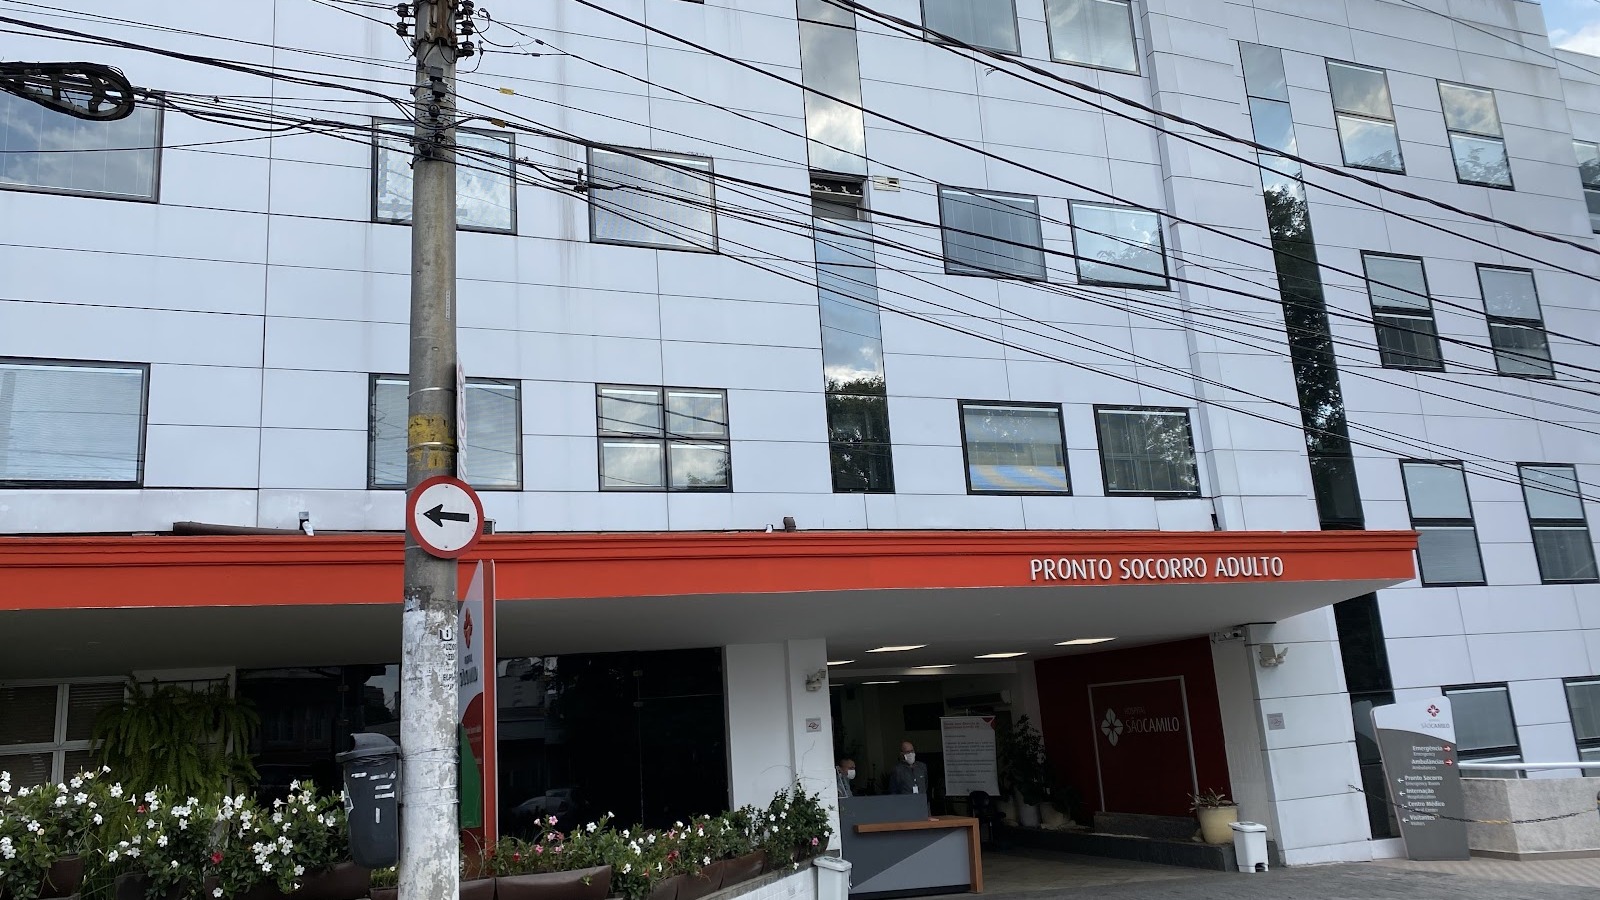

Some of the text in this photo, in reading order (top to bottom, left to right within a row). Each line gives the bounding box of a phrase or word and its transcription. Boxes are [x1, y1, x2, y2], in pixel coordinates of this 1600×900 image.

[1030, 556, 1284, 580] PRONTO SOCORRO ADULTO
